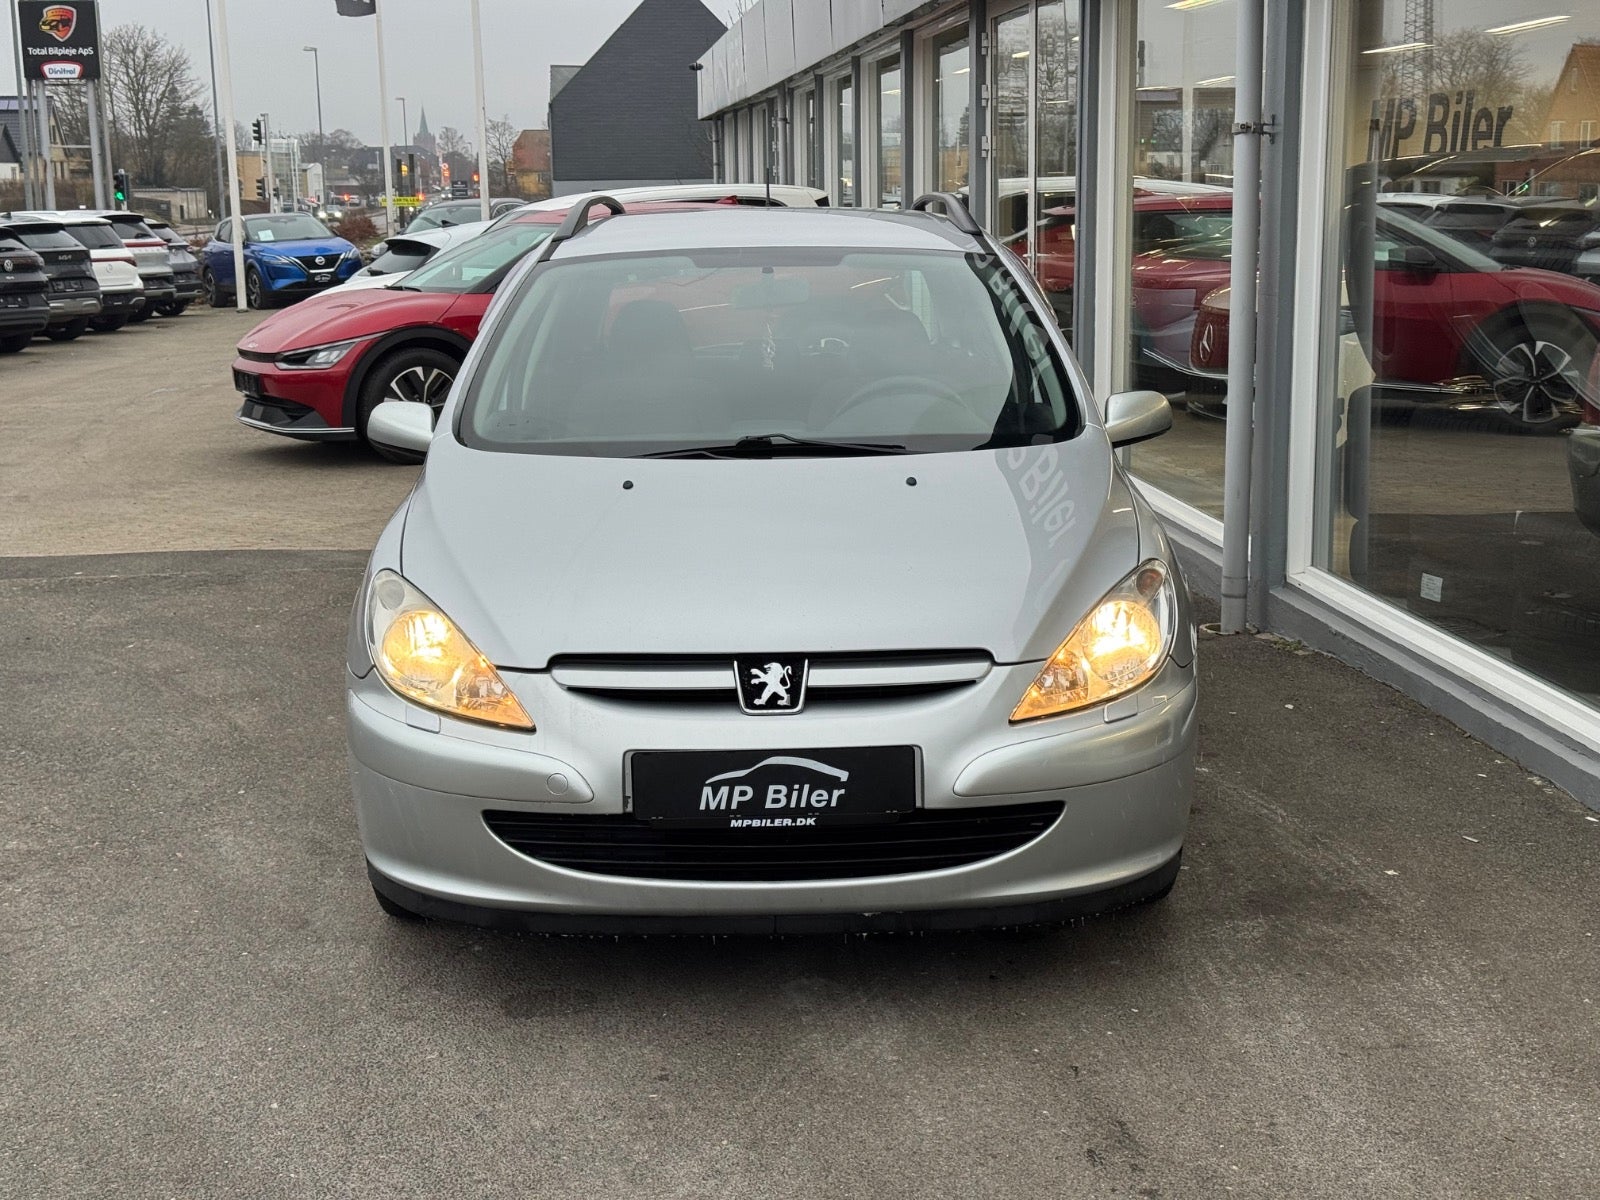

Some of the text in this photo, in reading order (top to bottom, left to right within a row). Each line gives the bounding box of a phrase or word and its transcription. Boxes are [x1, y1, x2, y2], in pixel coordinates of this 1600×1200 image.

[27, 46, 94, 56] Total Bilpleje ApS
[48, 67, 76, 75] Dinitrol
[1423, 90, 1513, 154] Biler
[700, 784, 846, 811] MP Biler
[730, 817, 816, 828] MPBILER.DK
